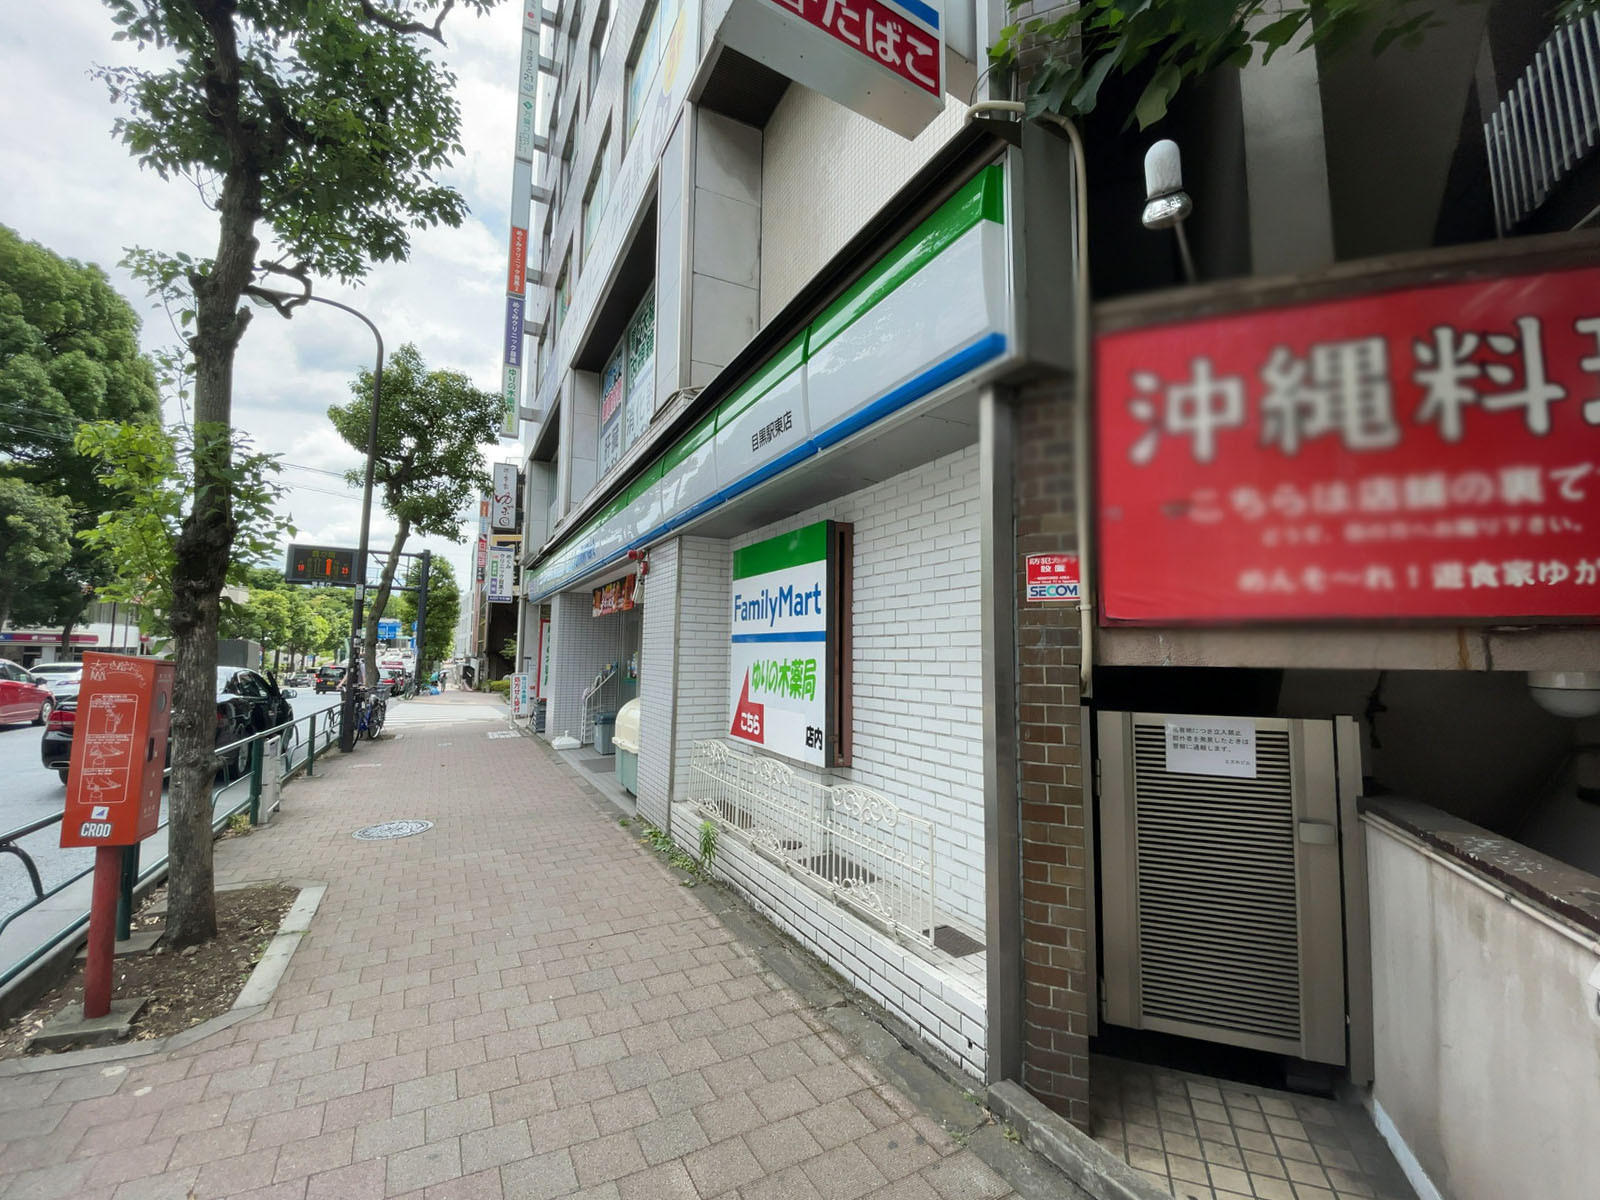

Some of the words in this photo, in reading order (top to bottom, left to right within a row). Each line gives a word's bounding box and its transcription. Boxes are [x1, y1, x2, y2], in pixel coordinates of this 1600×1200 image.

[782, 0, 936, 88] たばこ
[751, 410, 793, 452] 目黒駅東店
[734, 582, 822, 627] FamilyMart
[1030, 585, 1078, 597] SECOM
[751, 658, 817, 702] ゆりの木薬局
[740, 712, 760, 735] こちら
[805, 725, 823, 750] 店内
[80, 822, 112, 838] CROD
